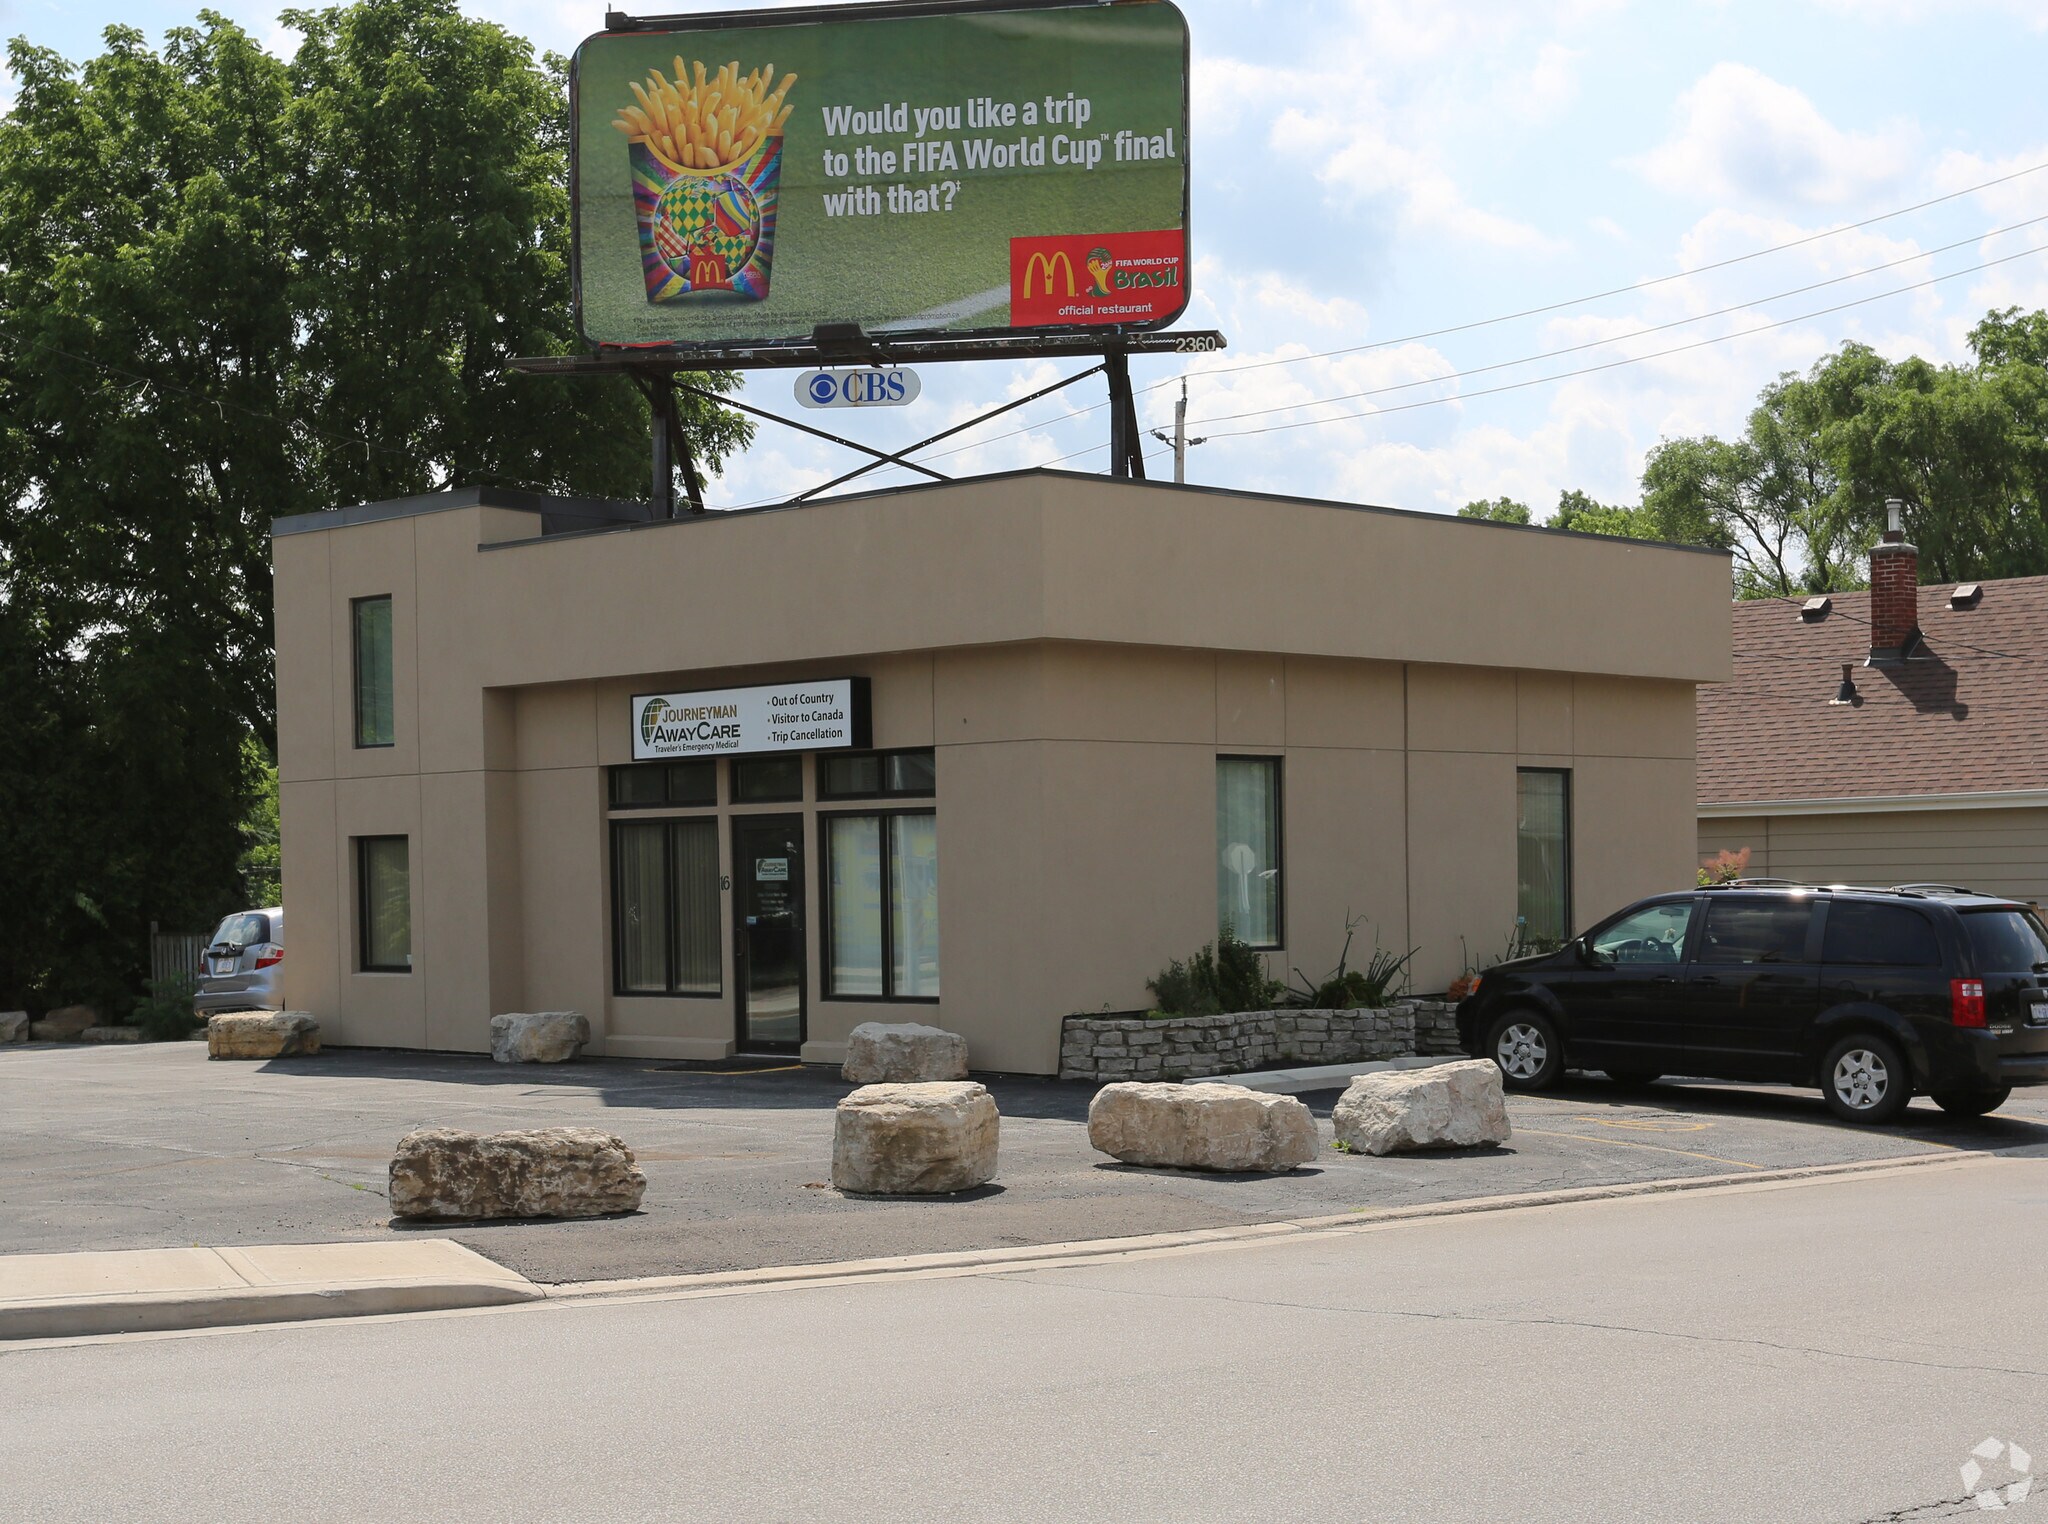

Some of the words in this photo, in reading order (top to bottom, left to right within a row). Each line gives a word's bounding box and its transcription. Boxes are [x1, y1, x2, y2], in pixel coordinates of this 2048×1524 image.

[822, 102, 908, 136] Would
[913, 106, 961, 139] you
[967, 97, 1016, 128] like
[1022, 101, 1038, 125] a
[1044, 92, 1091, 129] trip
[822, 149, 849, 177] to
[855, 145, 897, 175] the
[903, 140, 959, 173] FIFA
[962, 136, 1045, 169] World
[1114, 127, 1176, 161] final
[823, 185, 881, 217] with
[1115, 259, 1133, 267] FIFA
[1133, 257, 1163, 267] WORLD
[1163, 257, 1179, 265] CUP
[1113, 266, 1179, 289] Brasil
[1058, 305, 1094, 316] official
[1098, 302, 1153, 315] restaurant
[1175, 336, 1216, 352] 2360
[842, 371, 905, 403] CBS
[772, 696, 788, 706] Out
[789, 693, 799, 705] of
[800, 693, 834, 705] Country
[662, 704, 737, 723] JOURNEYMAN
[772, 712, 799, 724] Visitor
[801, 712, 810, 722] to
[812, 708, 844, 721] Canada
[772, 730, 789, 744] Trip
[790, 727, 843, 741] Cancellation
[655, 744, 682, 753] Traveler's
[682, 742, 715, 752] Emergency
[716, 740, 739, 749] Medical
[720, 875, 730, 891] 16
